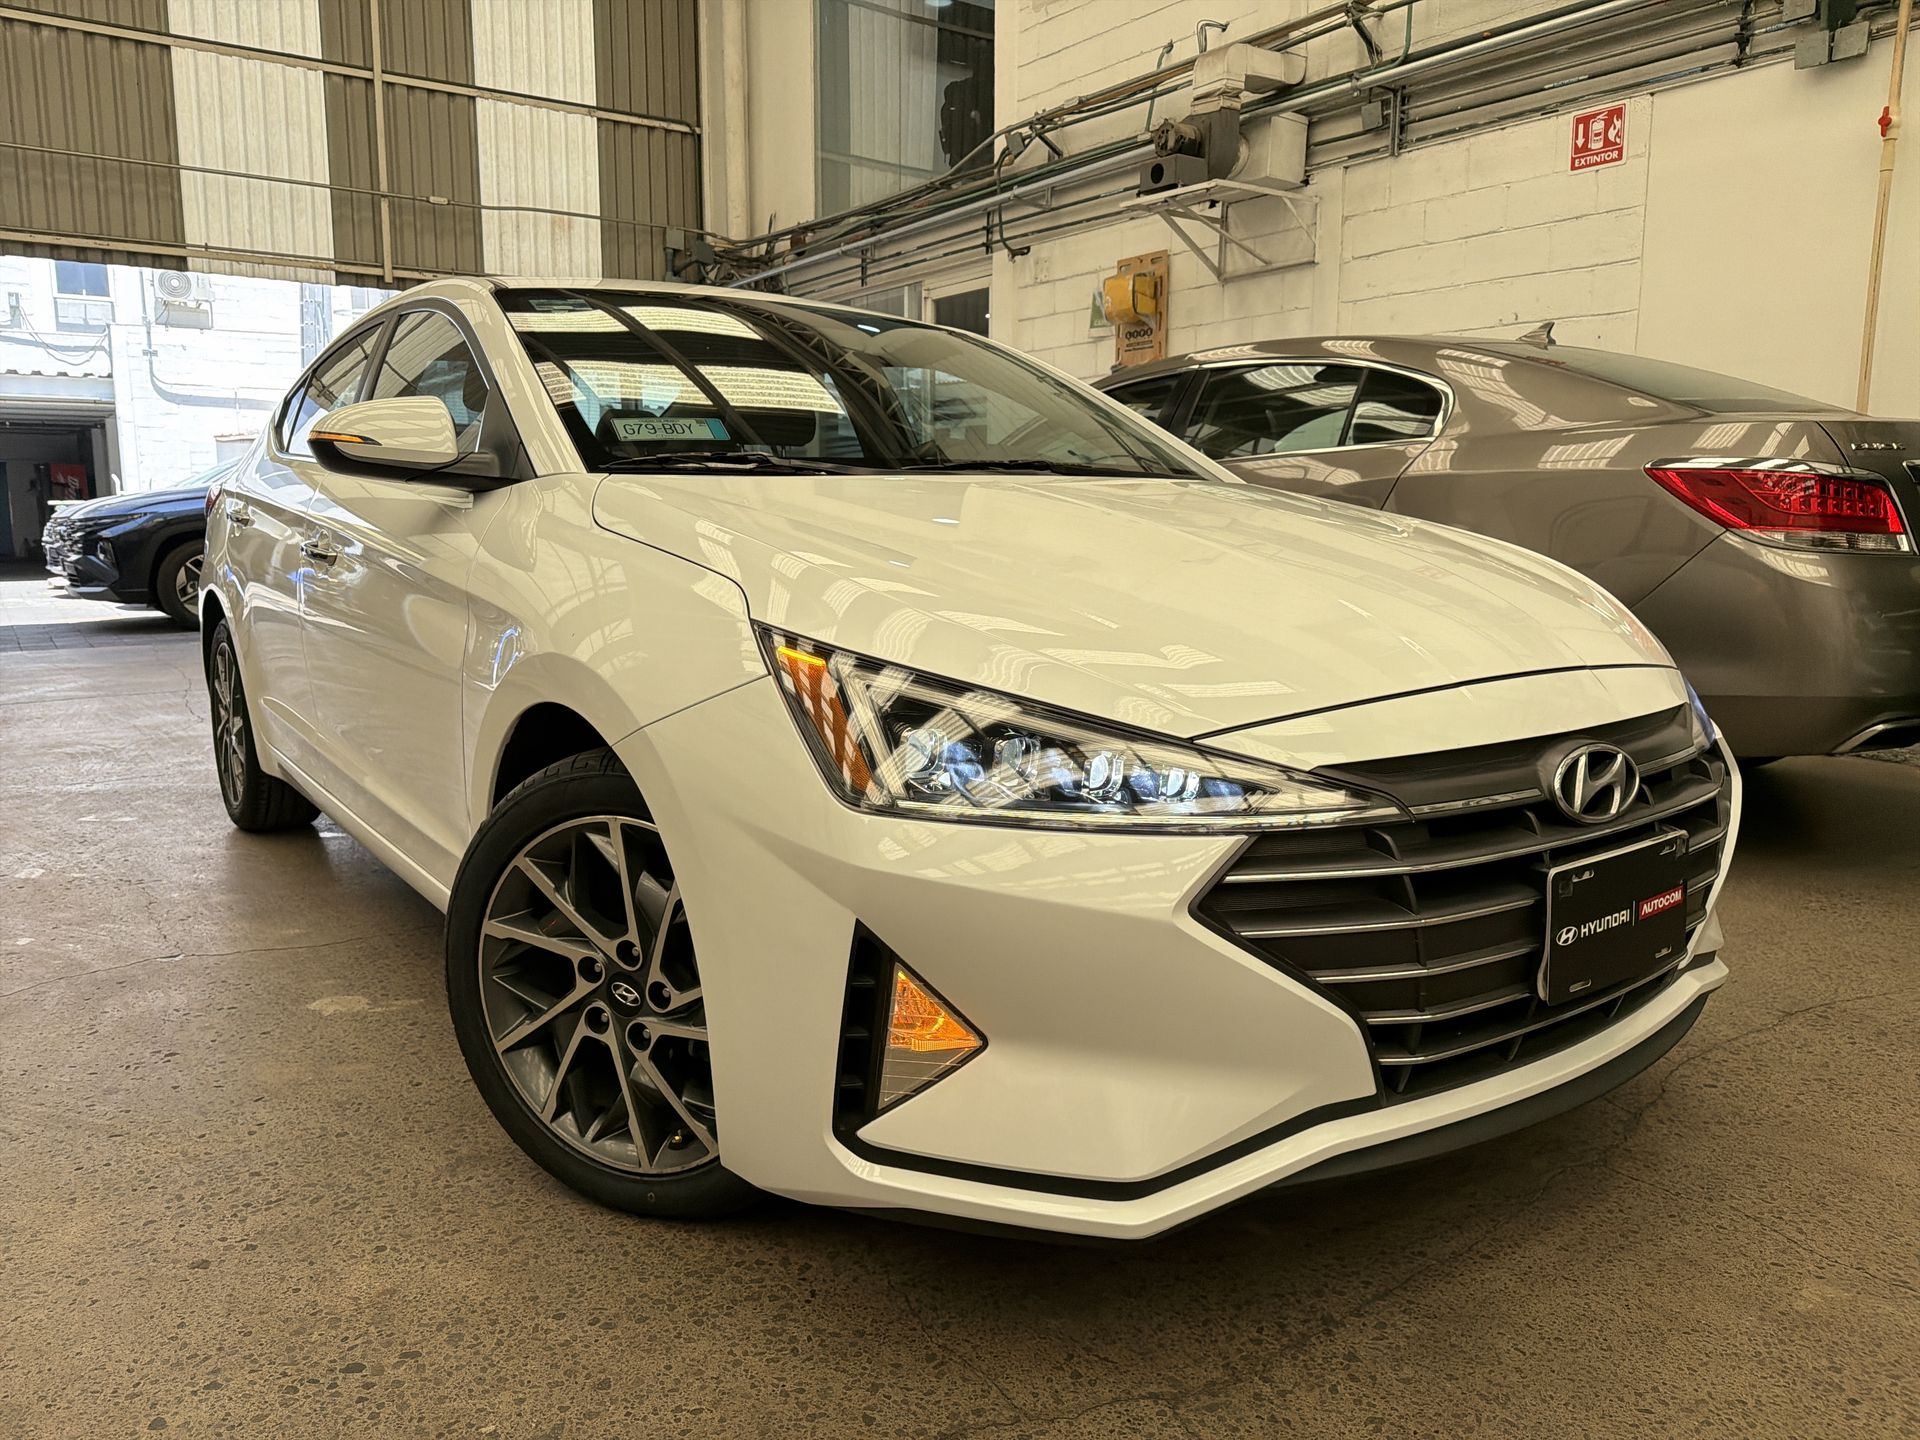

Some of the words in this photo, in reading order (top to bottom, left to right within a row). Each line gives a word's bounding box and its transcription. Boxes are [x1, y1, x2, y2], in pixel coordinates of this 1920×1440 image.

[1574, 150, 1619, 167] EXTINTOR
[623, 423, 694, 435] G79-BDY
[1580, 909, 1630, 938] HYUNDAI
[1641, 890, 1682, 916] AUTOCOM
